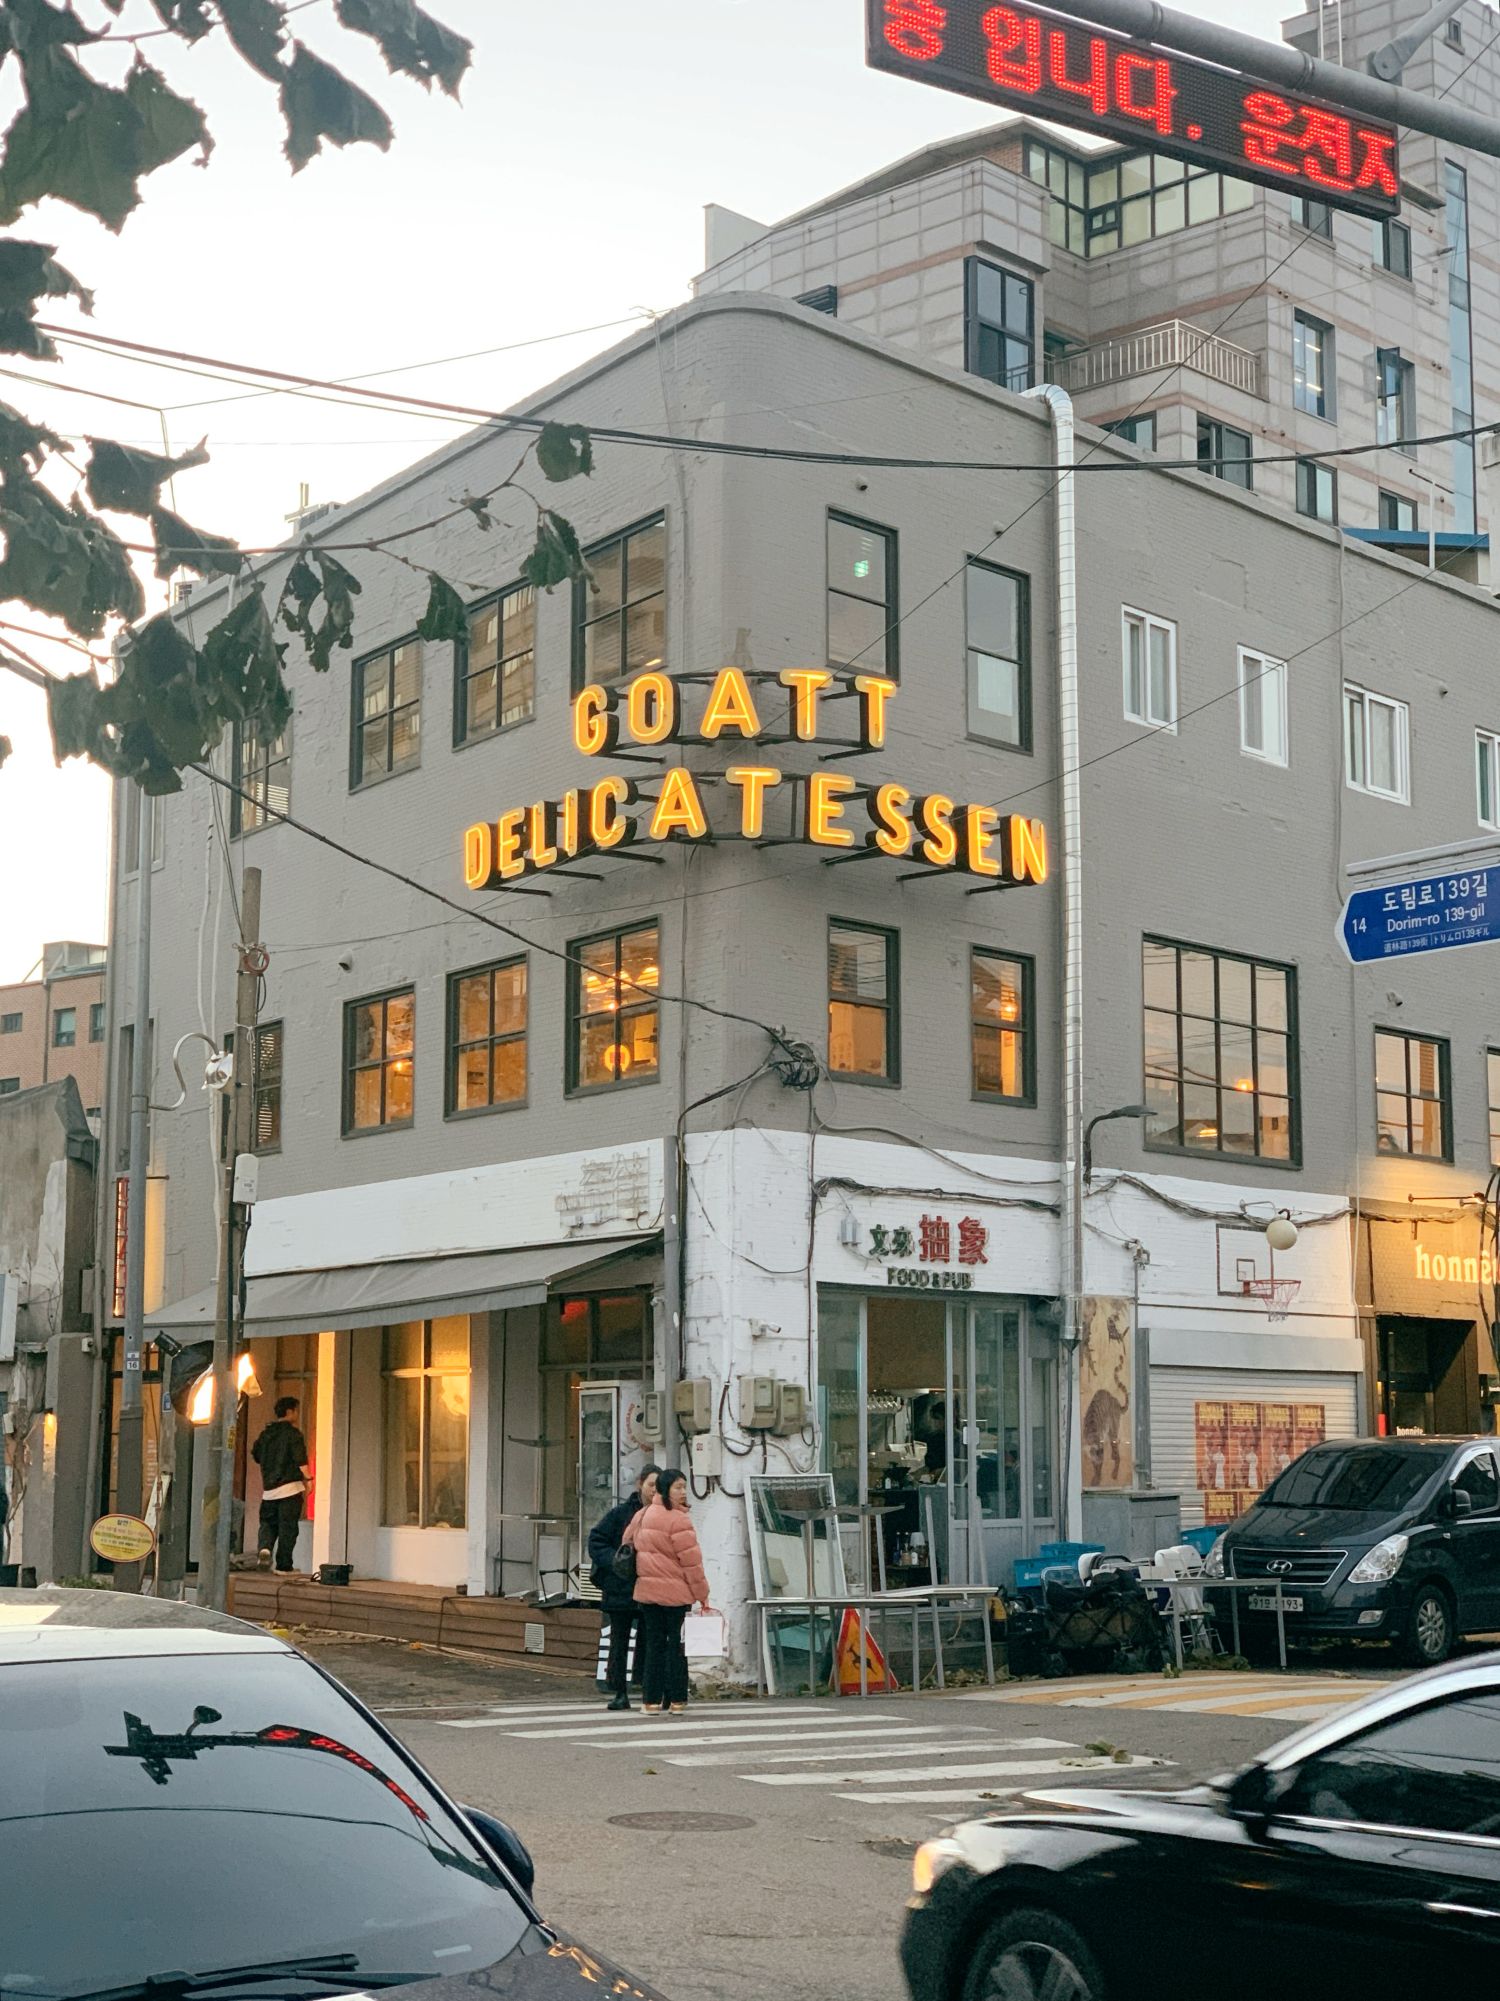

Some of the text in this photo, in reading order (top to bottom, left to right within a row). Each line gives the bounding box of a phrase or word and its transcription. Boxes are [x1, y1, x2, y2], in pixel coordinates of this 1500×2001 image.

[982, 6, 1203, 141] 입니다.
[573, 666, 898, 756] GOATT
[463, 766, 1050, 891] DELICATESSEN
[1382, 872, 1488, 912] 도림로139길
[1352, 917, 1367, 935] 14
[1387, 903, 1485, 933] Dorim-ro 139-gil
[887, 1267, 930, 1287] FOOD
[942, 1271, 974, 1289] PUB
[128, 1361, 138, 1369] 16
